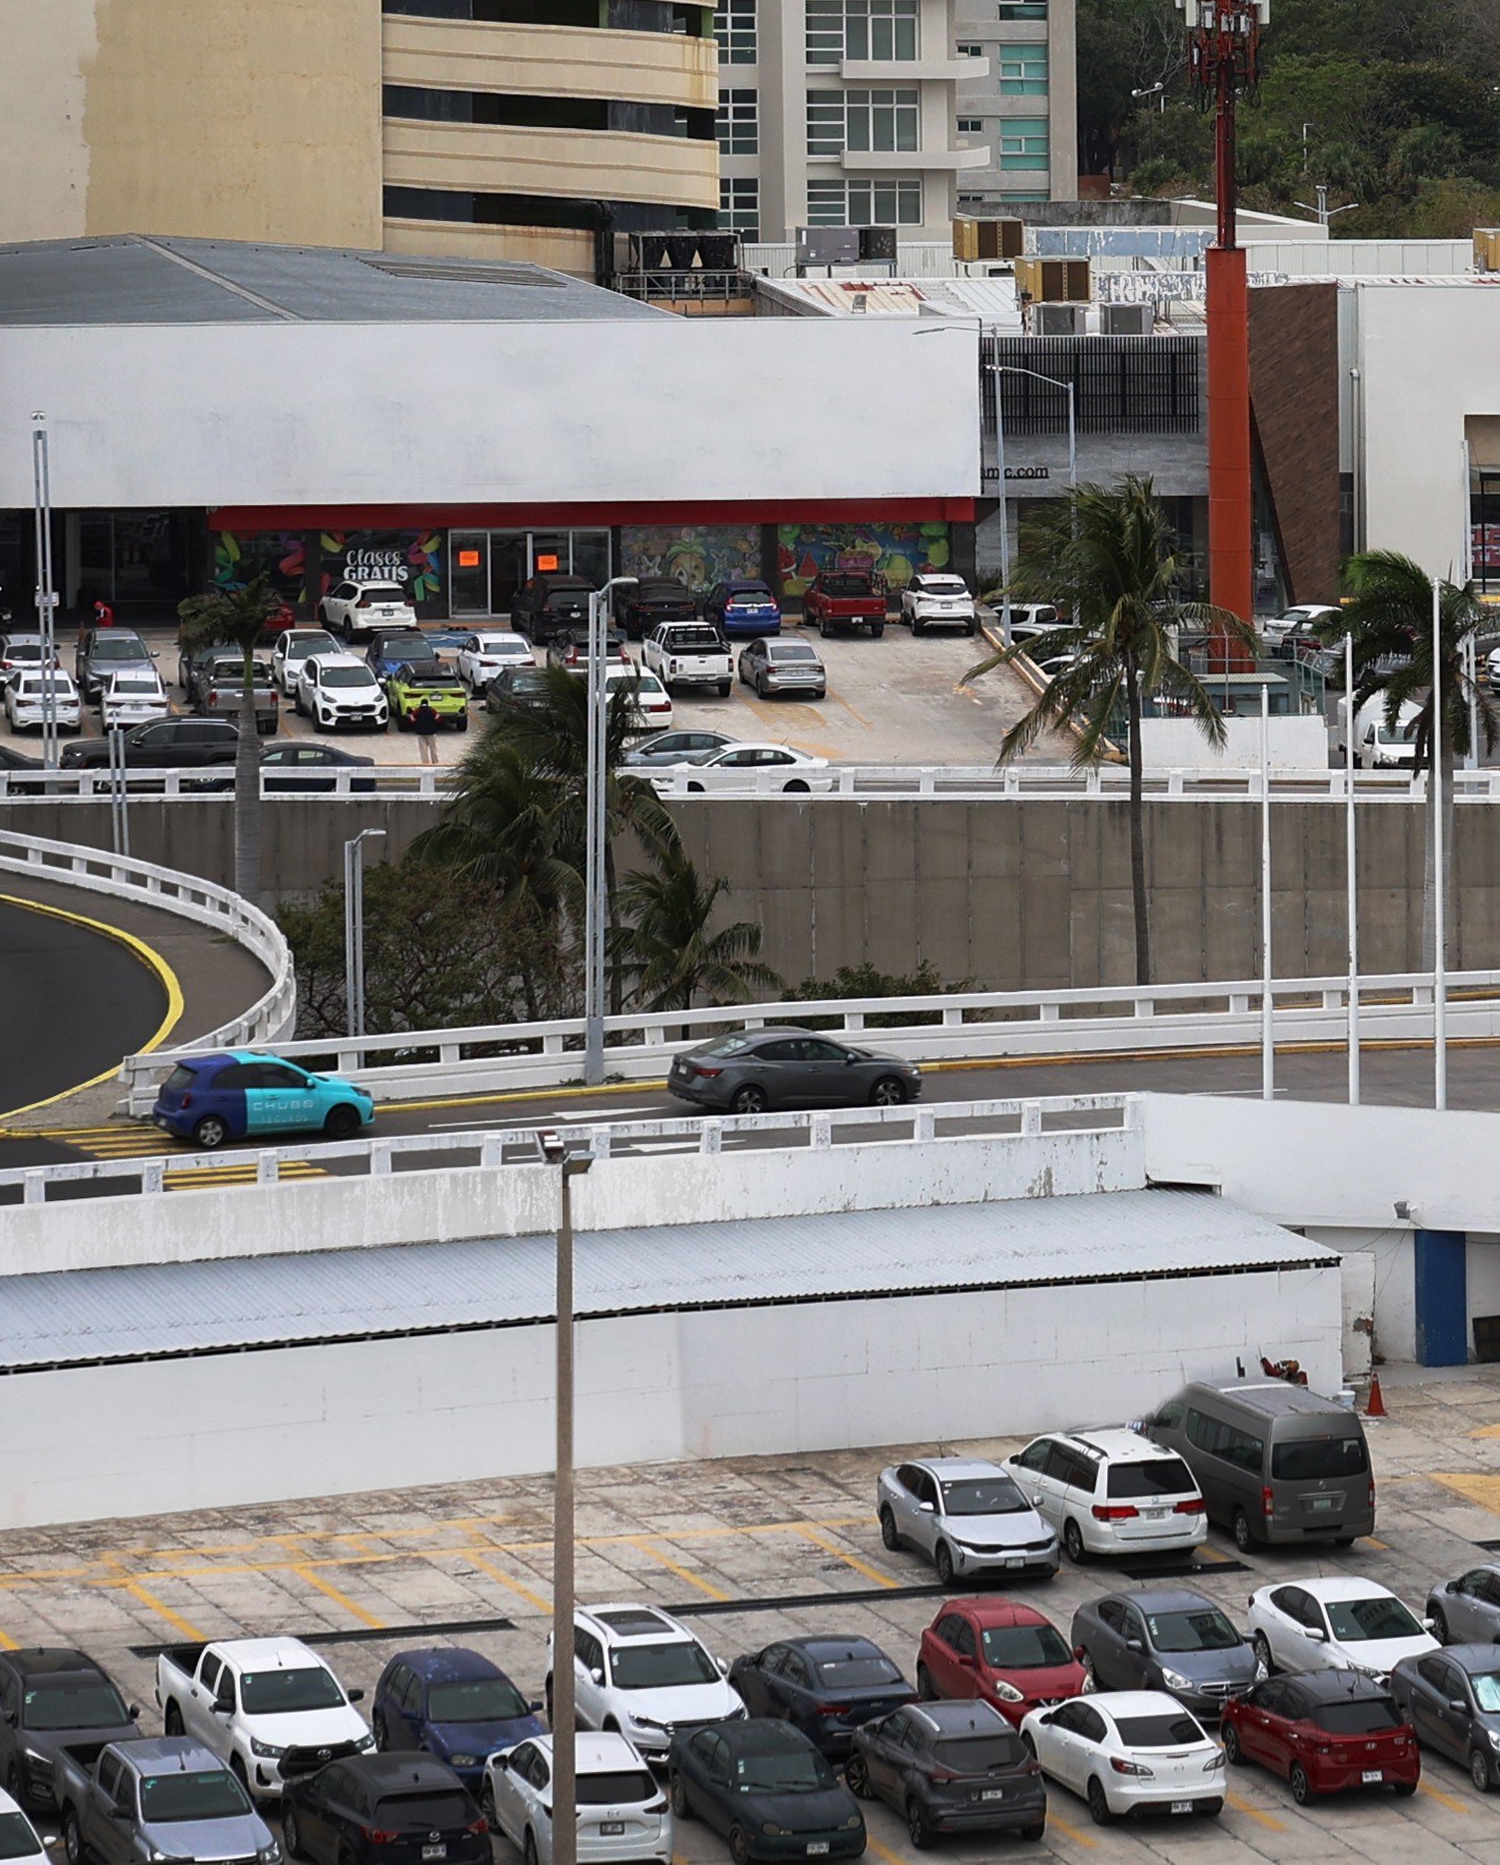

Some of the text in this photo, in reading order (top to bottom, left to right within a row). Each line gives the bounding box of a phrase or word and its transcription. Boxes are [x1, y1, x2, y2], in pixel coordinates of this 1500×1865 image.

[346, 548, 403, 566] Clases
[343, 566, 409, 581] GRATIS
[252, 1100, 314, 1111] CHUBB
